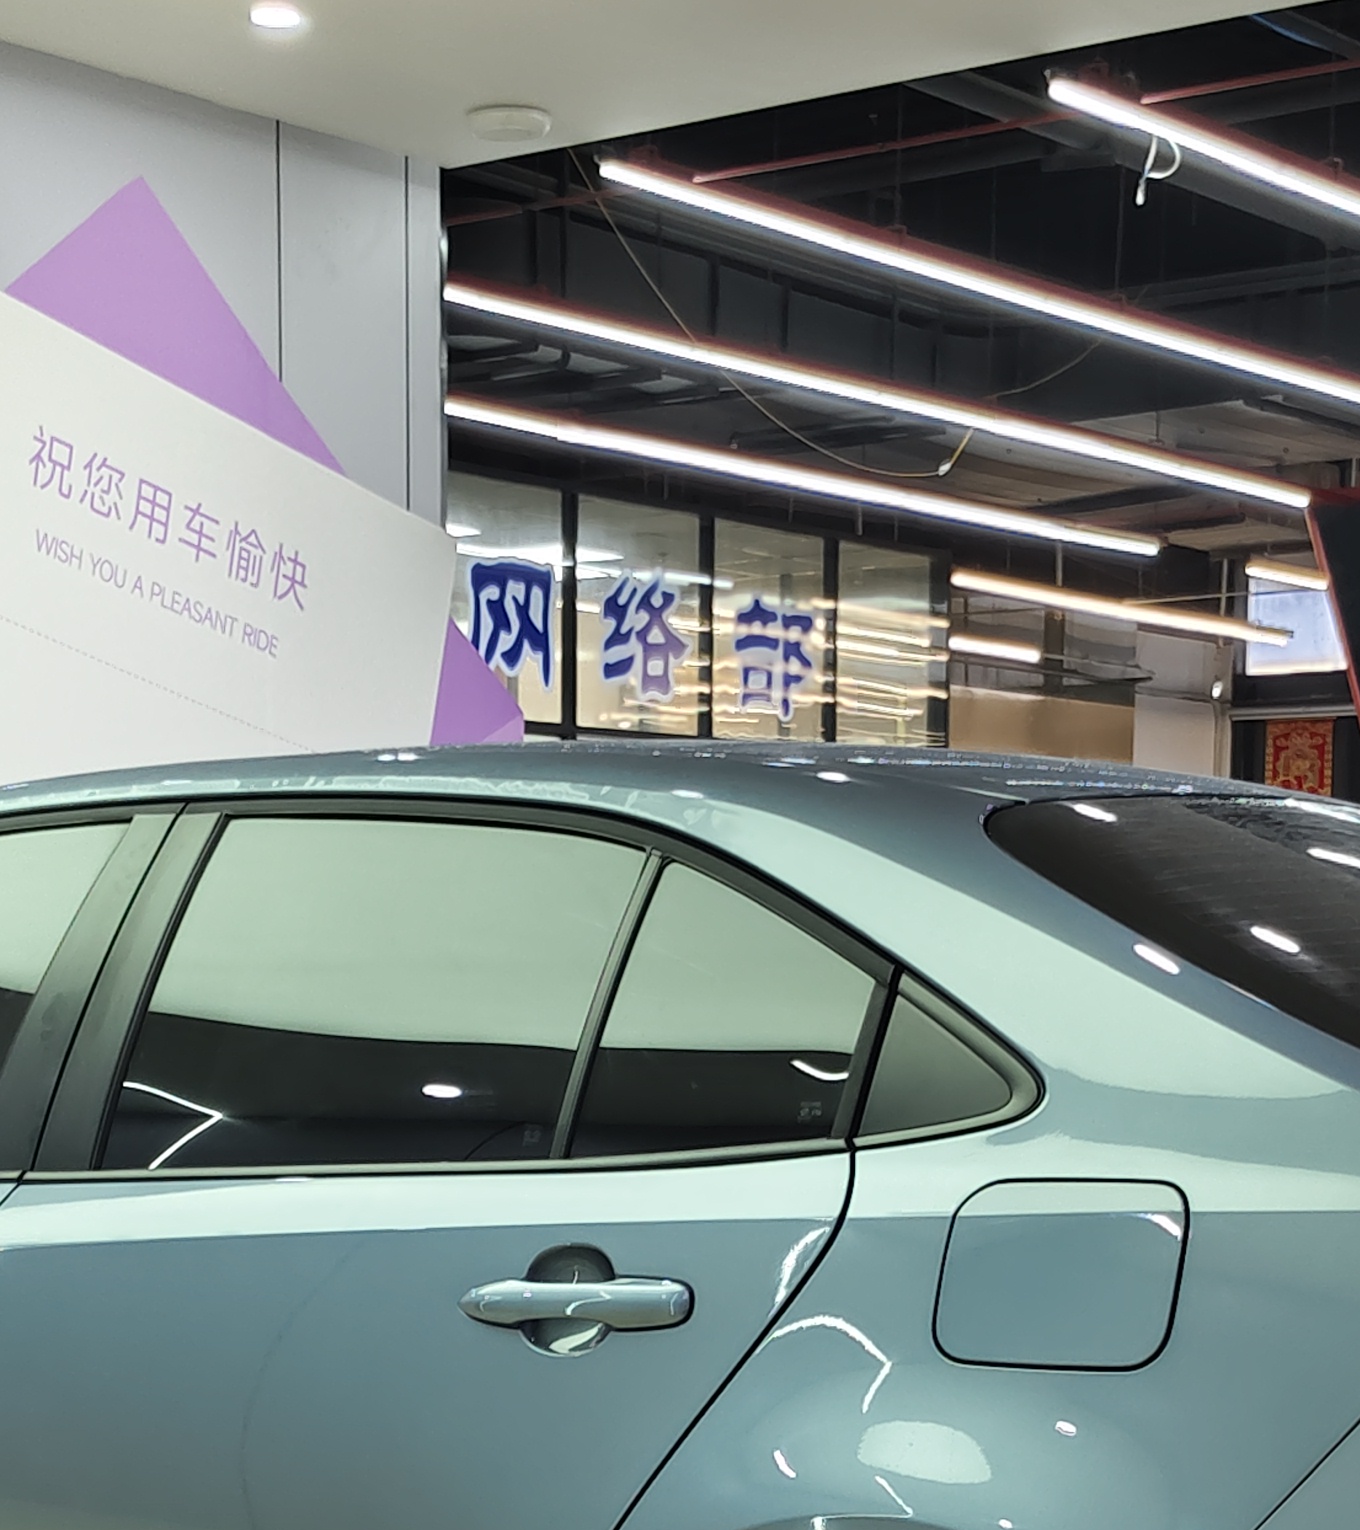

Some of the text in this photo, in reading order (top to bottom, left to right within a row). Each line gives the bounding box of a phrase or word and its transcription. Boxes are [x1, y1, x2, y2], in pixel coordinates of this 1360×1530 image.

[28, 424, 309, 612] 祝您用车愉快
[35, 527, 279, 660] WISH YOU A PLEASANT RIDE
[470, 560, 814, 719] 网络部
